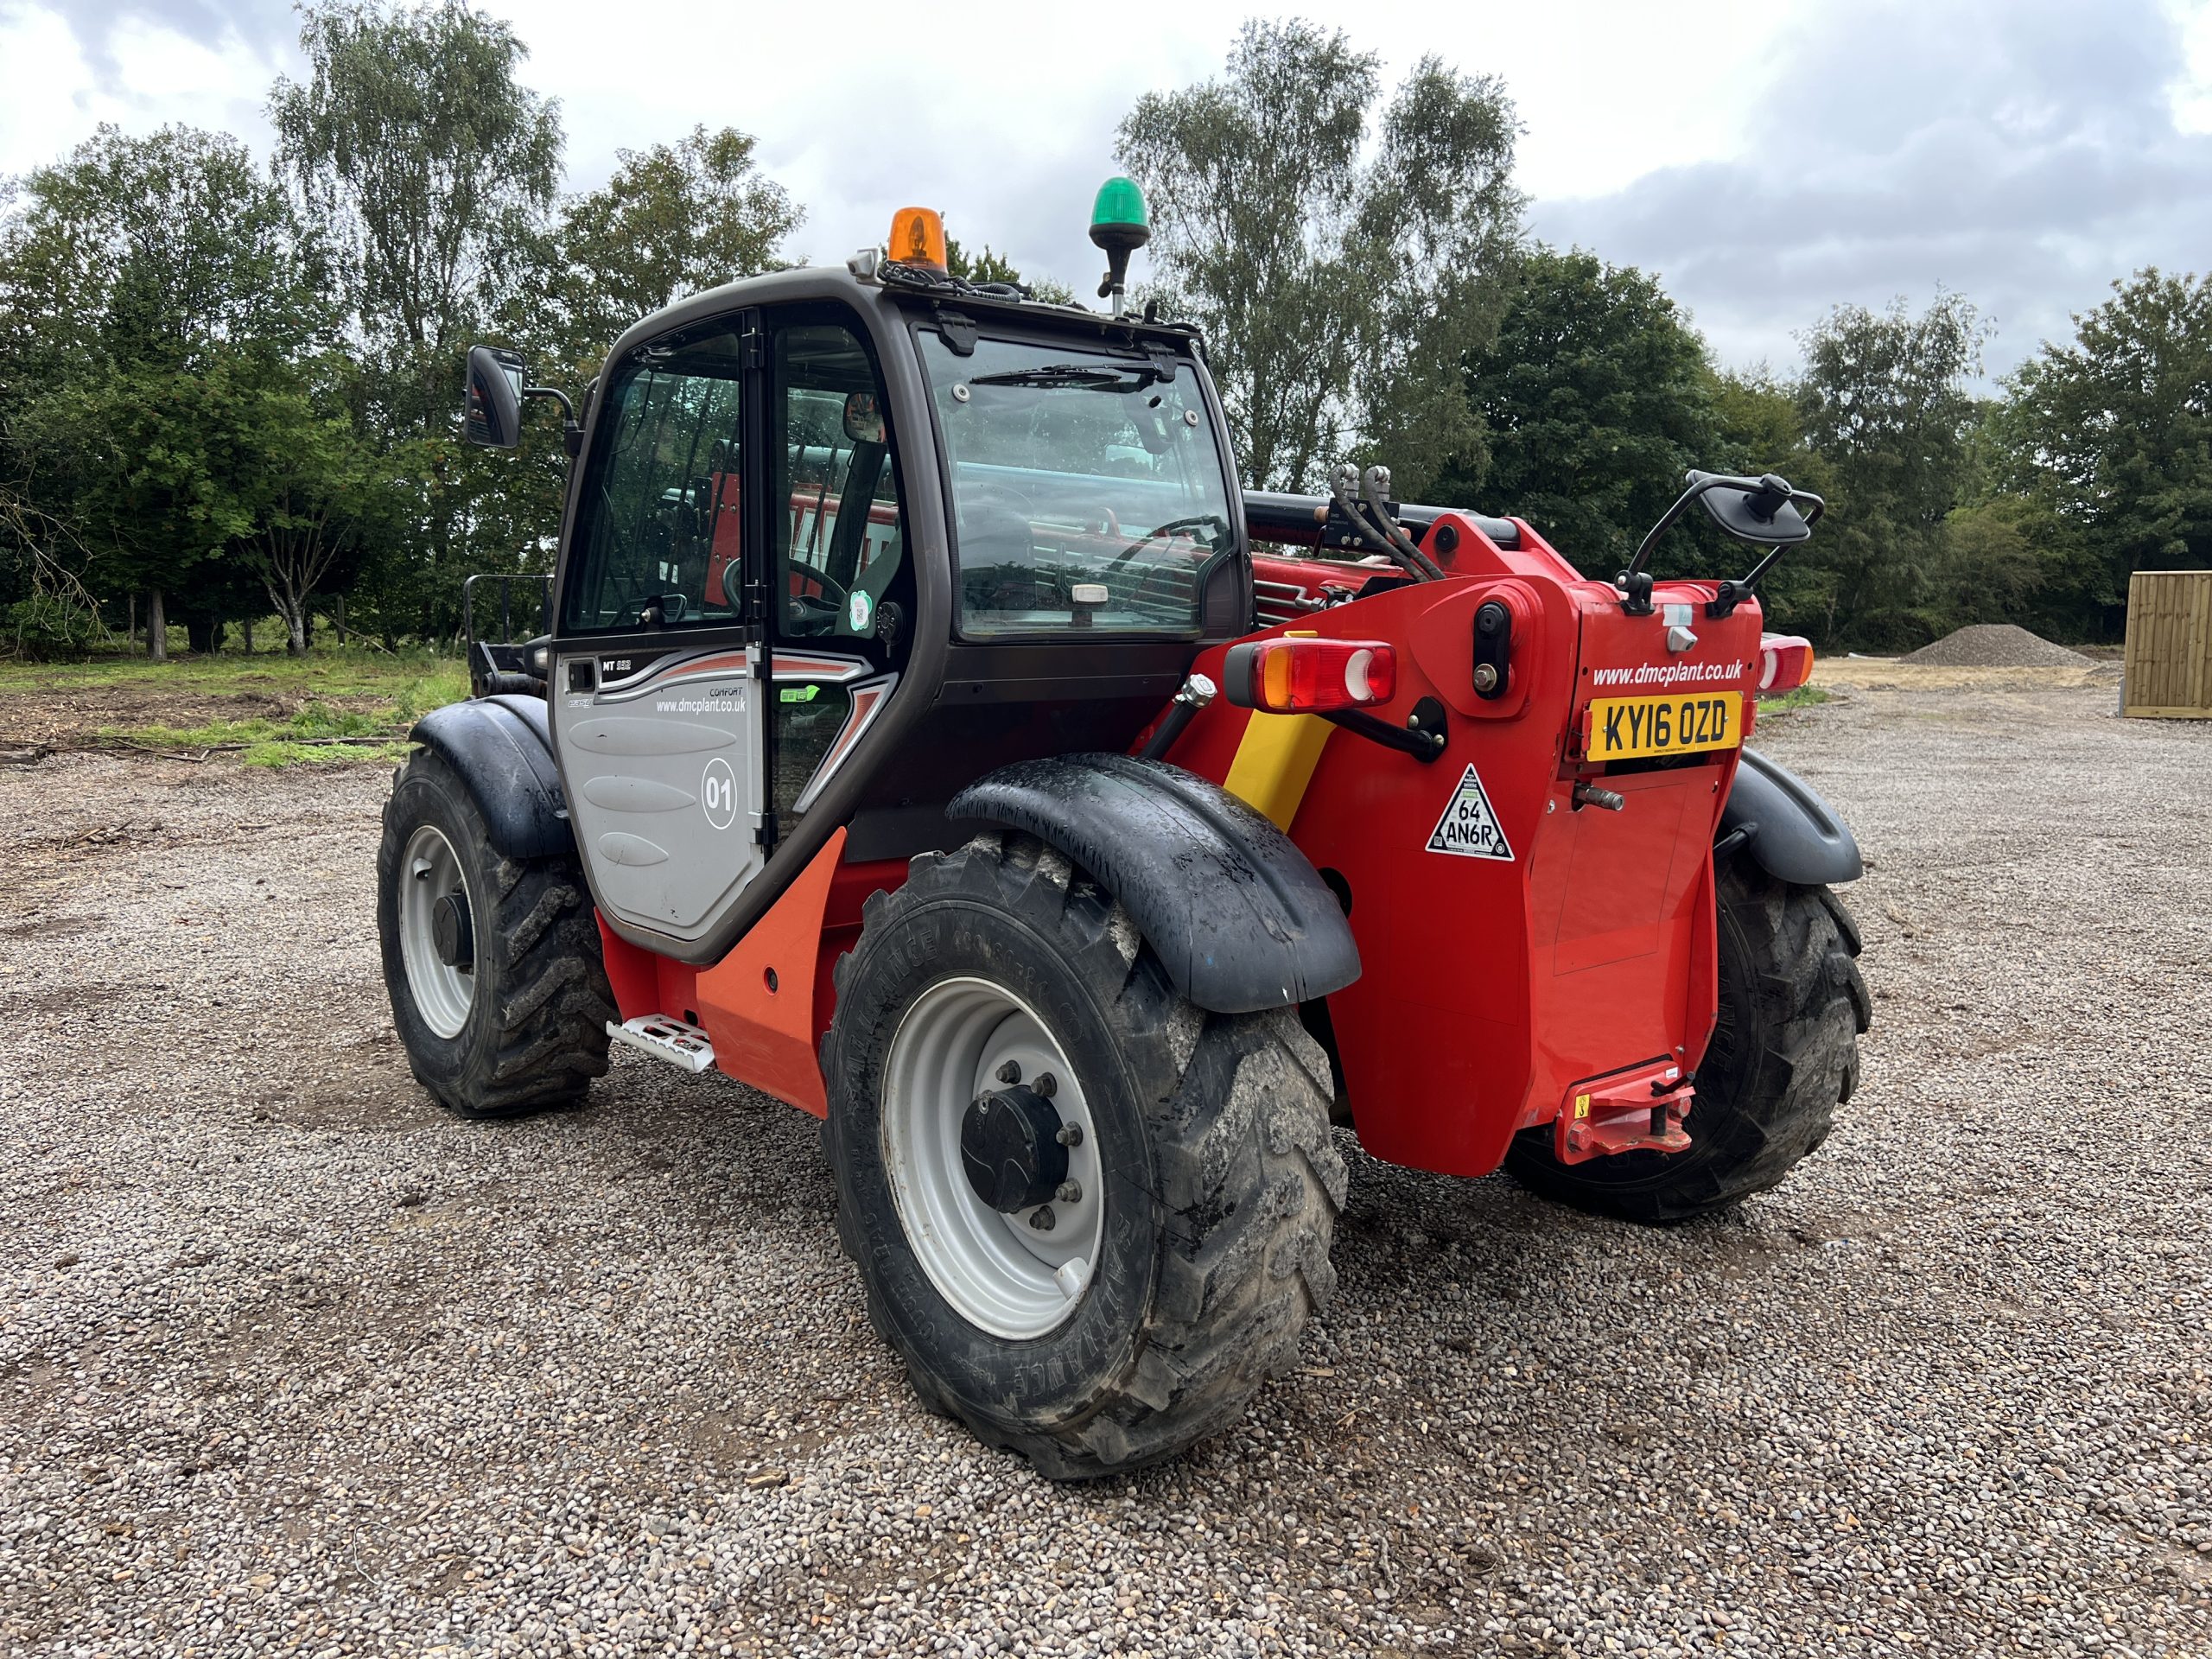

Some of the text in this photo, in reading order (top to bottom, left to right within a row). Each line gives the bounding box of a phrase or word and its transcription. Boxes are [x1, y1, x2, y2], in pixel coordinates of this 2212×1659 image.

[603, 661, 615, 671] MT
[1593, 659, 1743, 688] www.dmcplant.co.uk
[709, 687, 743, 697] COMFORT
[657, 697, 746, 715] www.dmcplant.co.uk
[1605, 699, 1726, 751] KY16 OZD
[706, 777, 731, 810] 01
[1459, 799, 1481, 823] 64
[1446, 822, 1493, 847] AN6R
